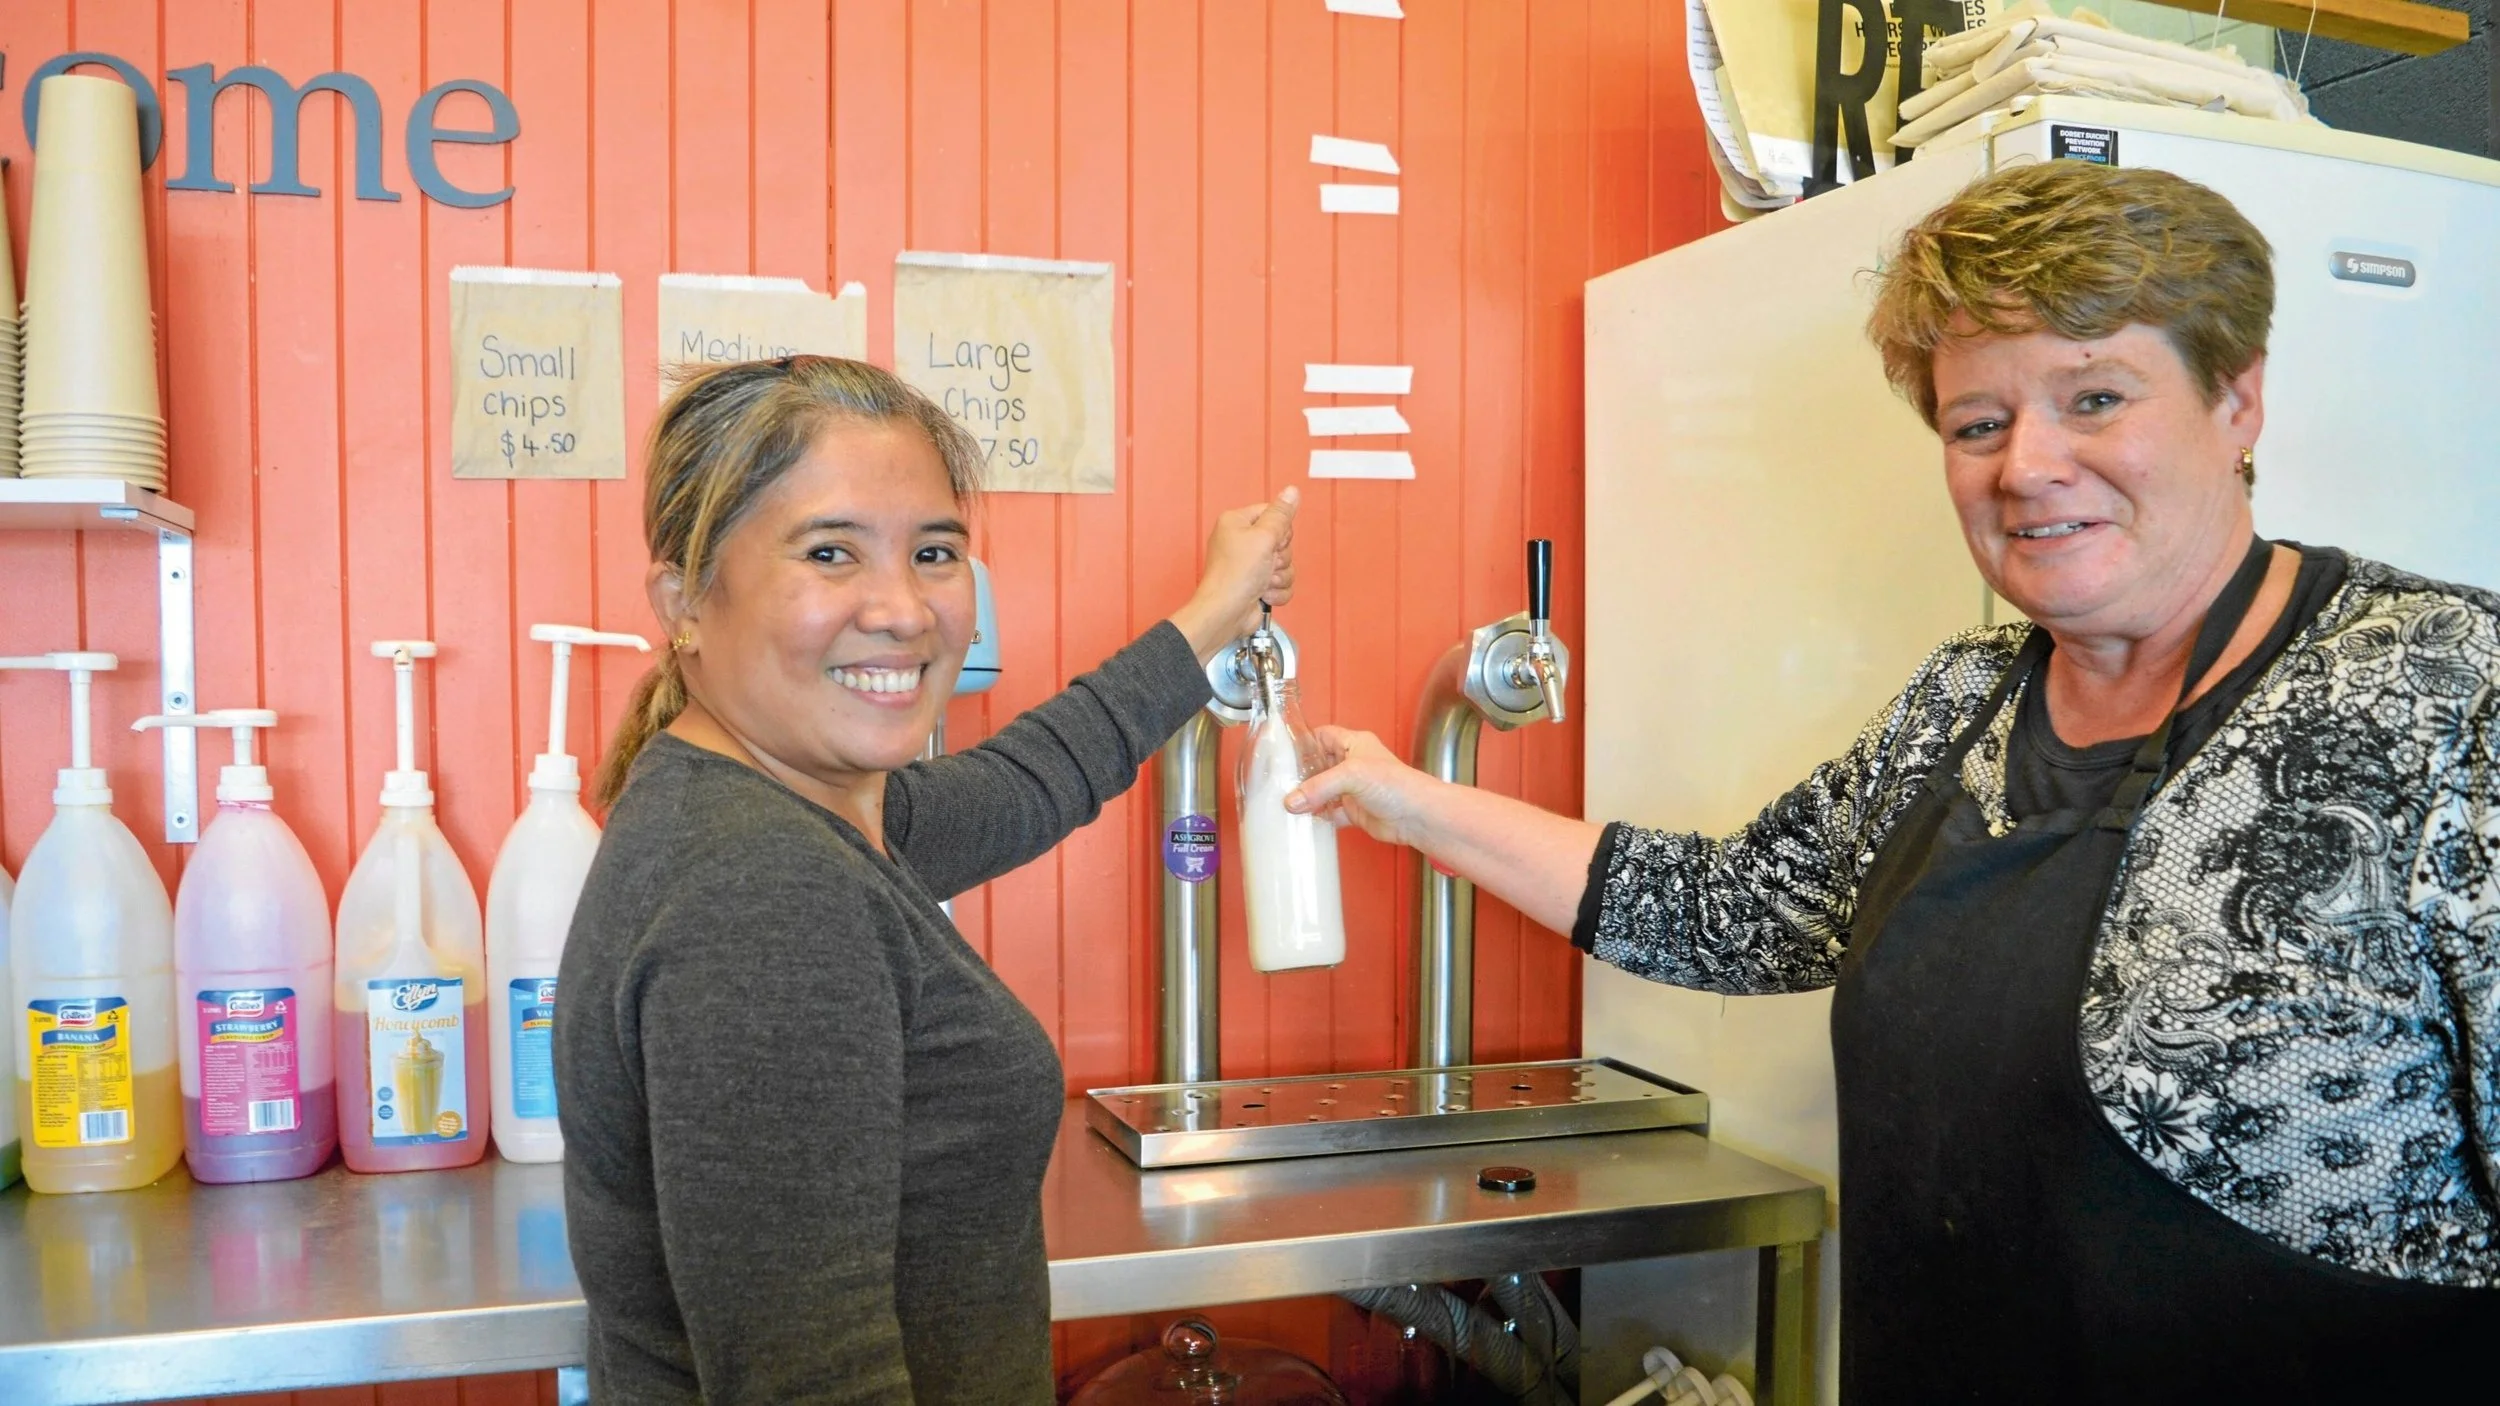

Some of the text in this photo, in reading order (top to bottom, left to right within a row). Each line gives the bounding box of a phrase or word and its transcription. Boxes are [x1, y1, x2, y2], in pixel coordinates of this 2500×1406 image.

[0, 51, 521, 209] ome
[2060, 130, 2084, 138] DORSET
[2065, 138, 2105, 147] PREVENTION
[480, 334, 575, 381] Small
[929, 332, 1032, 392] Large
[500, 429, 576, 469] $4.50
[1173, 844, 1215, 853] Full Cream
[215, 1019, 278, 1033] STRAWBERRY
[375, 1014, 460, 1032] Honeycomb
[57, 1032, 100, 1042] BANANA
